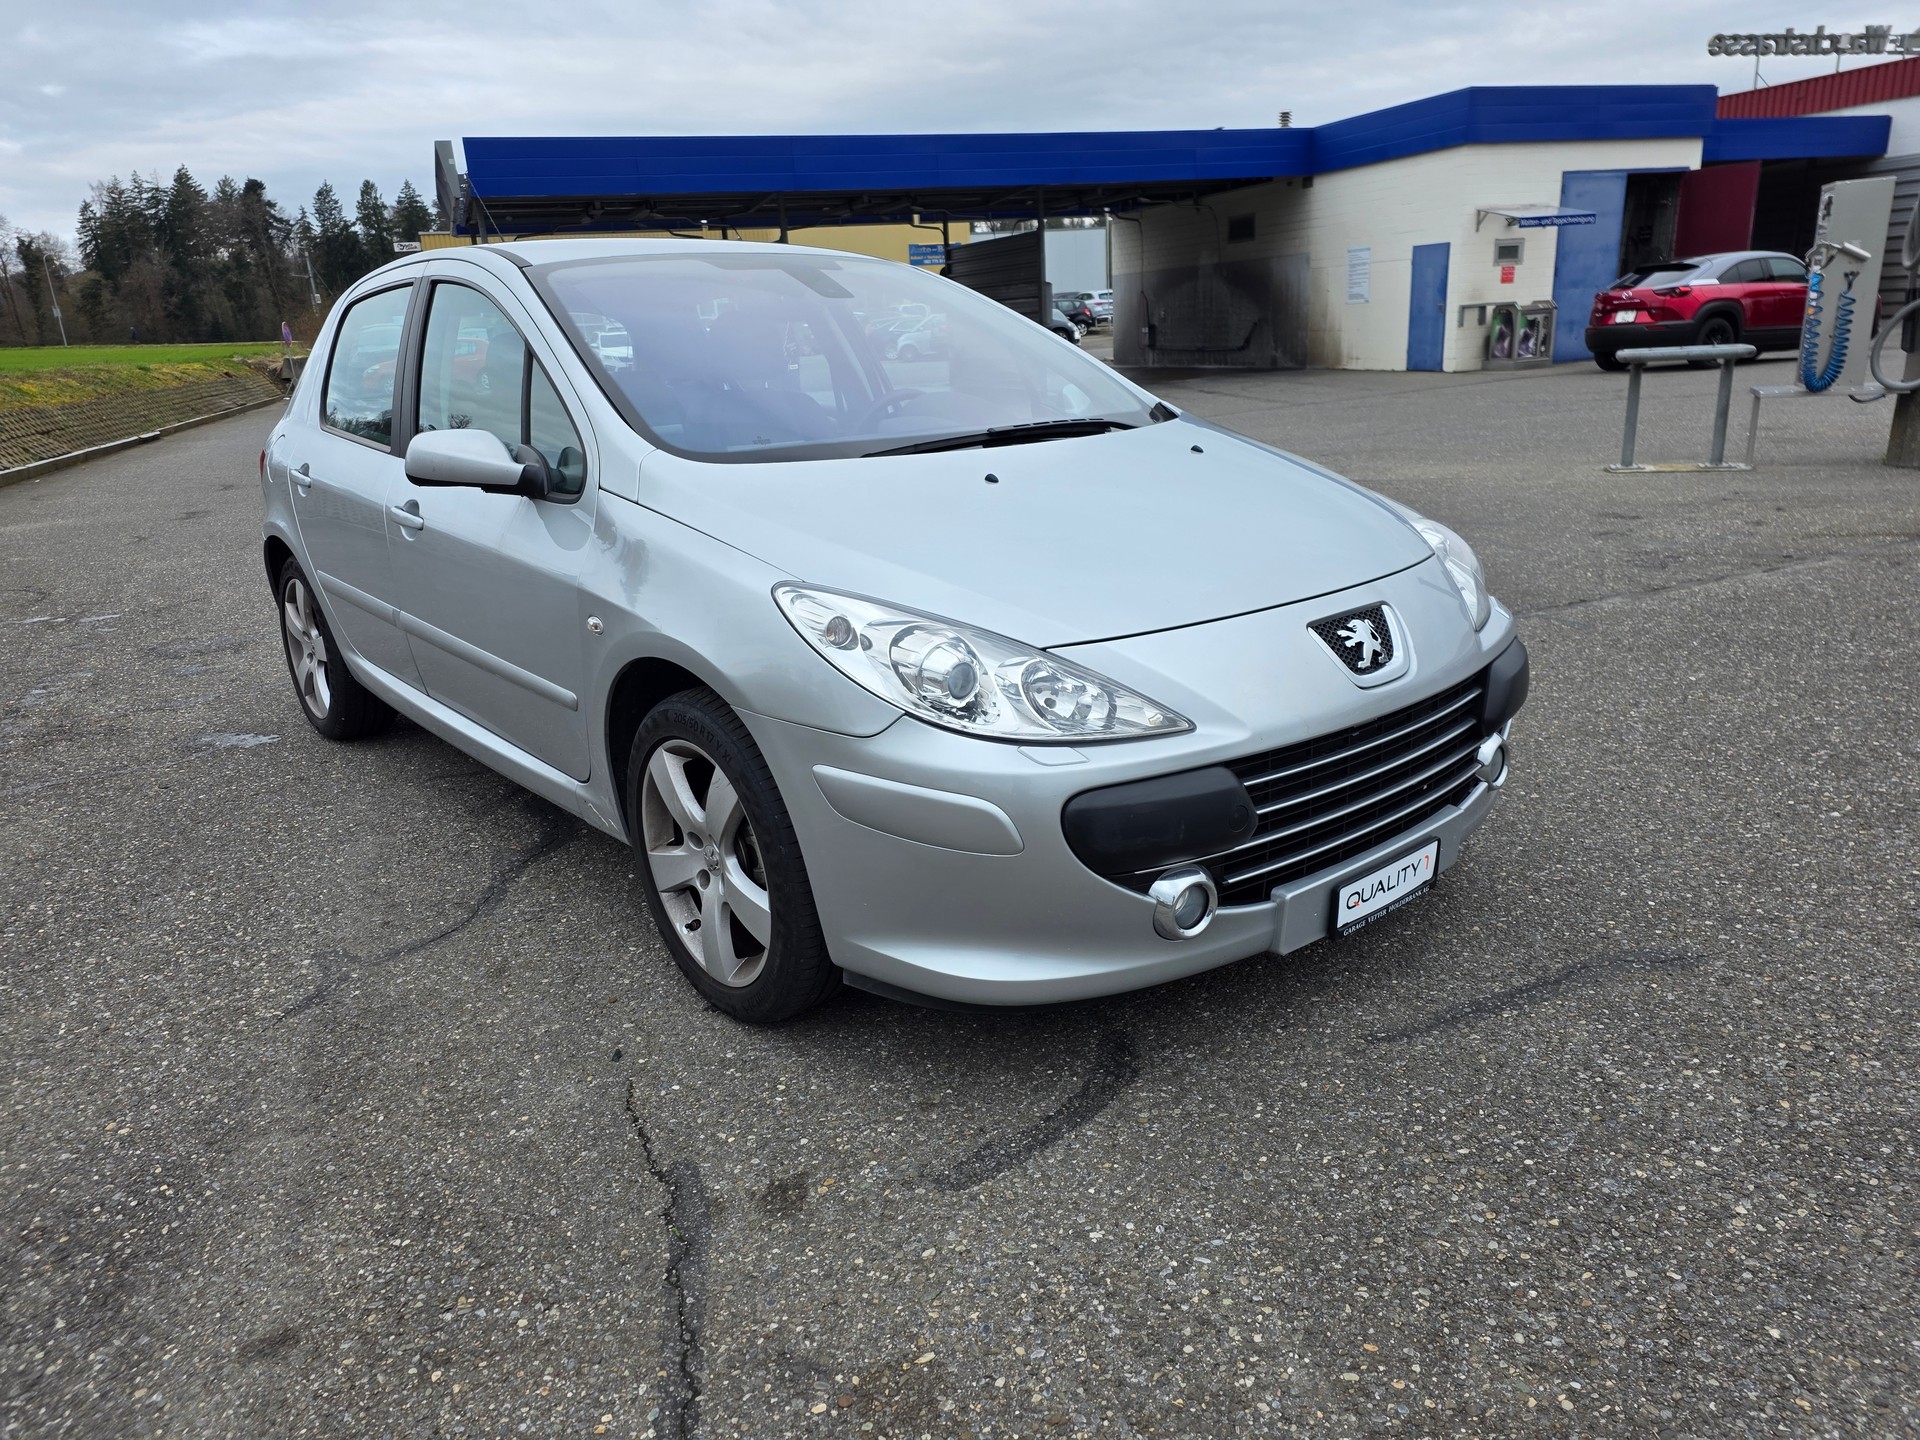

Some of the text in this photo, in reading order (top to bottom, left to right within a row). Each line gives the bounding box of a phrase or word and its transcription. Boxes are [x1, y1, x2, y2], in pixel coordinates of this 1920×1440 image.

[673, 712, 699, 732] 205/50
[700, 726, 706, 736] R
[706, 731, 715, 743] 17
[1343, 919, 1366, 936] GARAGE
